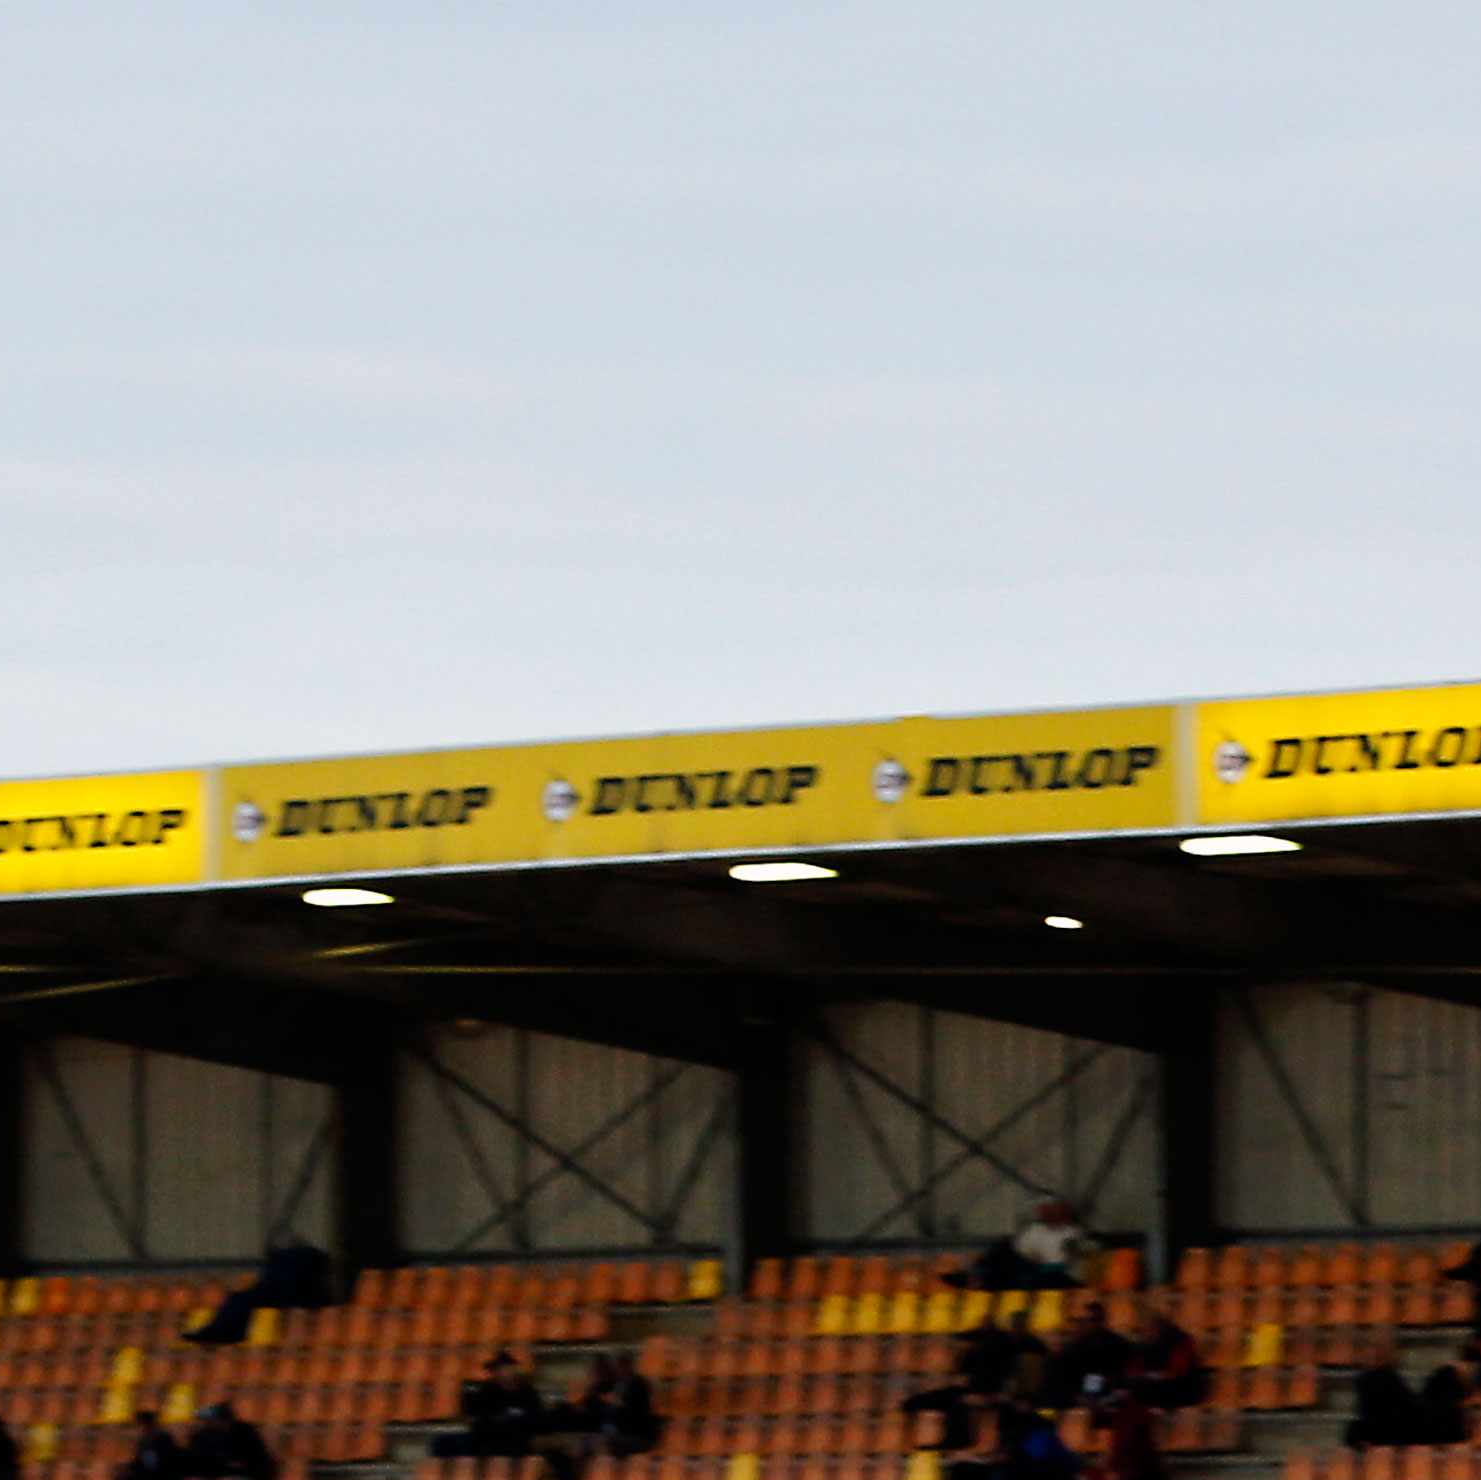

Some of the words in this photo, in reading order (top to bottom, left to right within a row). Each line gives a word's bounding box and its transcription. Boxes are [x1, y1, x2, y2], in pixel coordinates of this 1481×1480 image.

[587, 765, 819, 816] DUNLOP
[919, 745, 1160, 797] DUNLOP
[273, 785, 492, 837] DUNLOP
